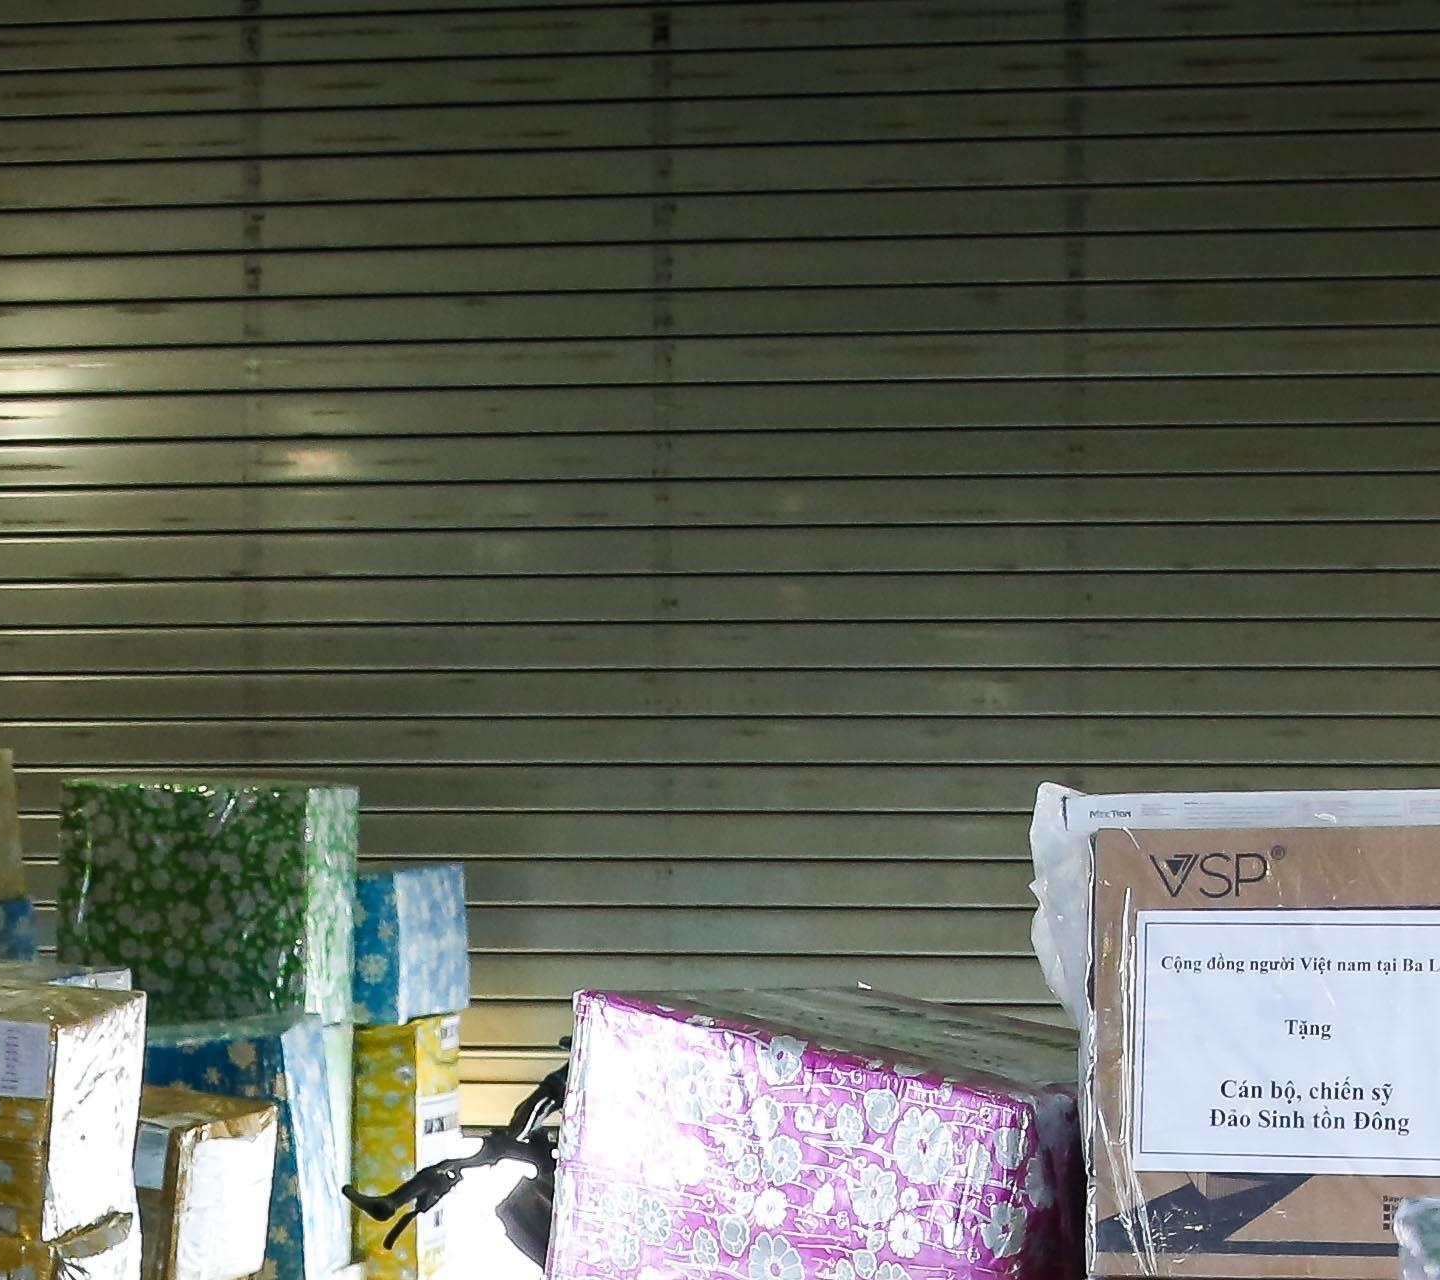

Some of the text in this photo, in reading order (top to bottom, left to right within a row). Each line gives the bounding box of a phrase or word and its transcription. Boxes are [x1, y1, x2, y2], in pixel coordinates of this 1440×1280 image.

[1149, 852, 1269, 899] VSP
[1161, 955, 1202, 974] Cộng
[1206, 952, 1245, 975] đồng
[1249, 956, 1295, 975] người
[1300, 955, 1332, 975] Việt
[1337, 960, 1371, 973] nam
[1377, 957, 1397, 975] tại
[1403, 958, 1423, 973] Ba
[1284, 1018, 1332, 1040] Tặng
[1220, 1076, 1394, 1106] Cán bộ, chiến sỹ
[1209, 1105, 1410, 1135] Đảo Sinh tồn Đông
